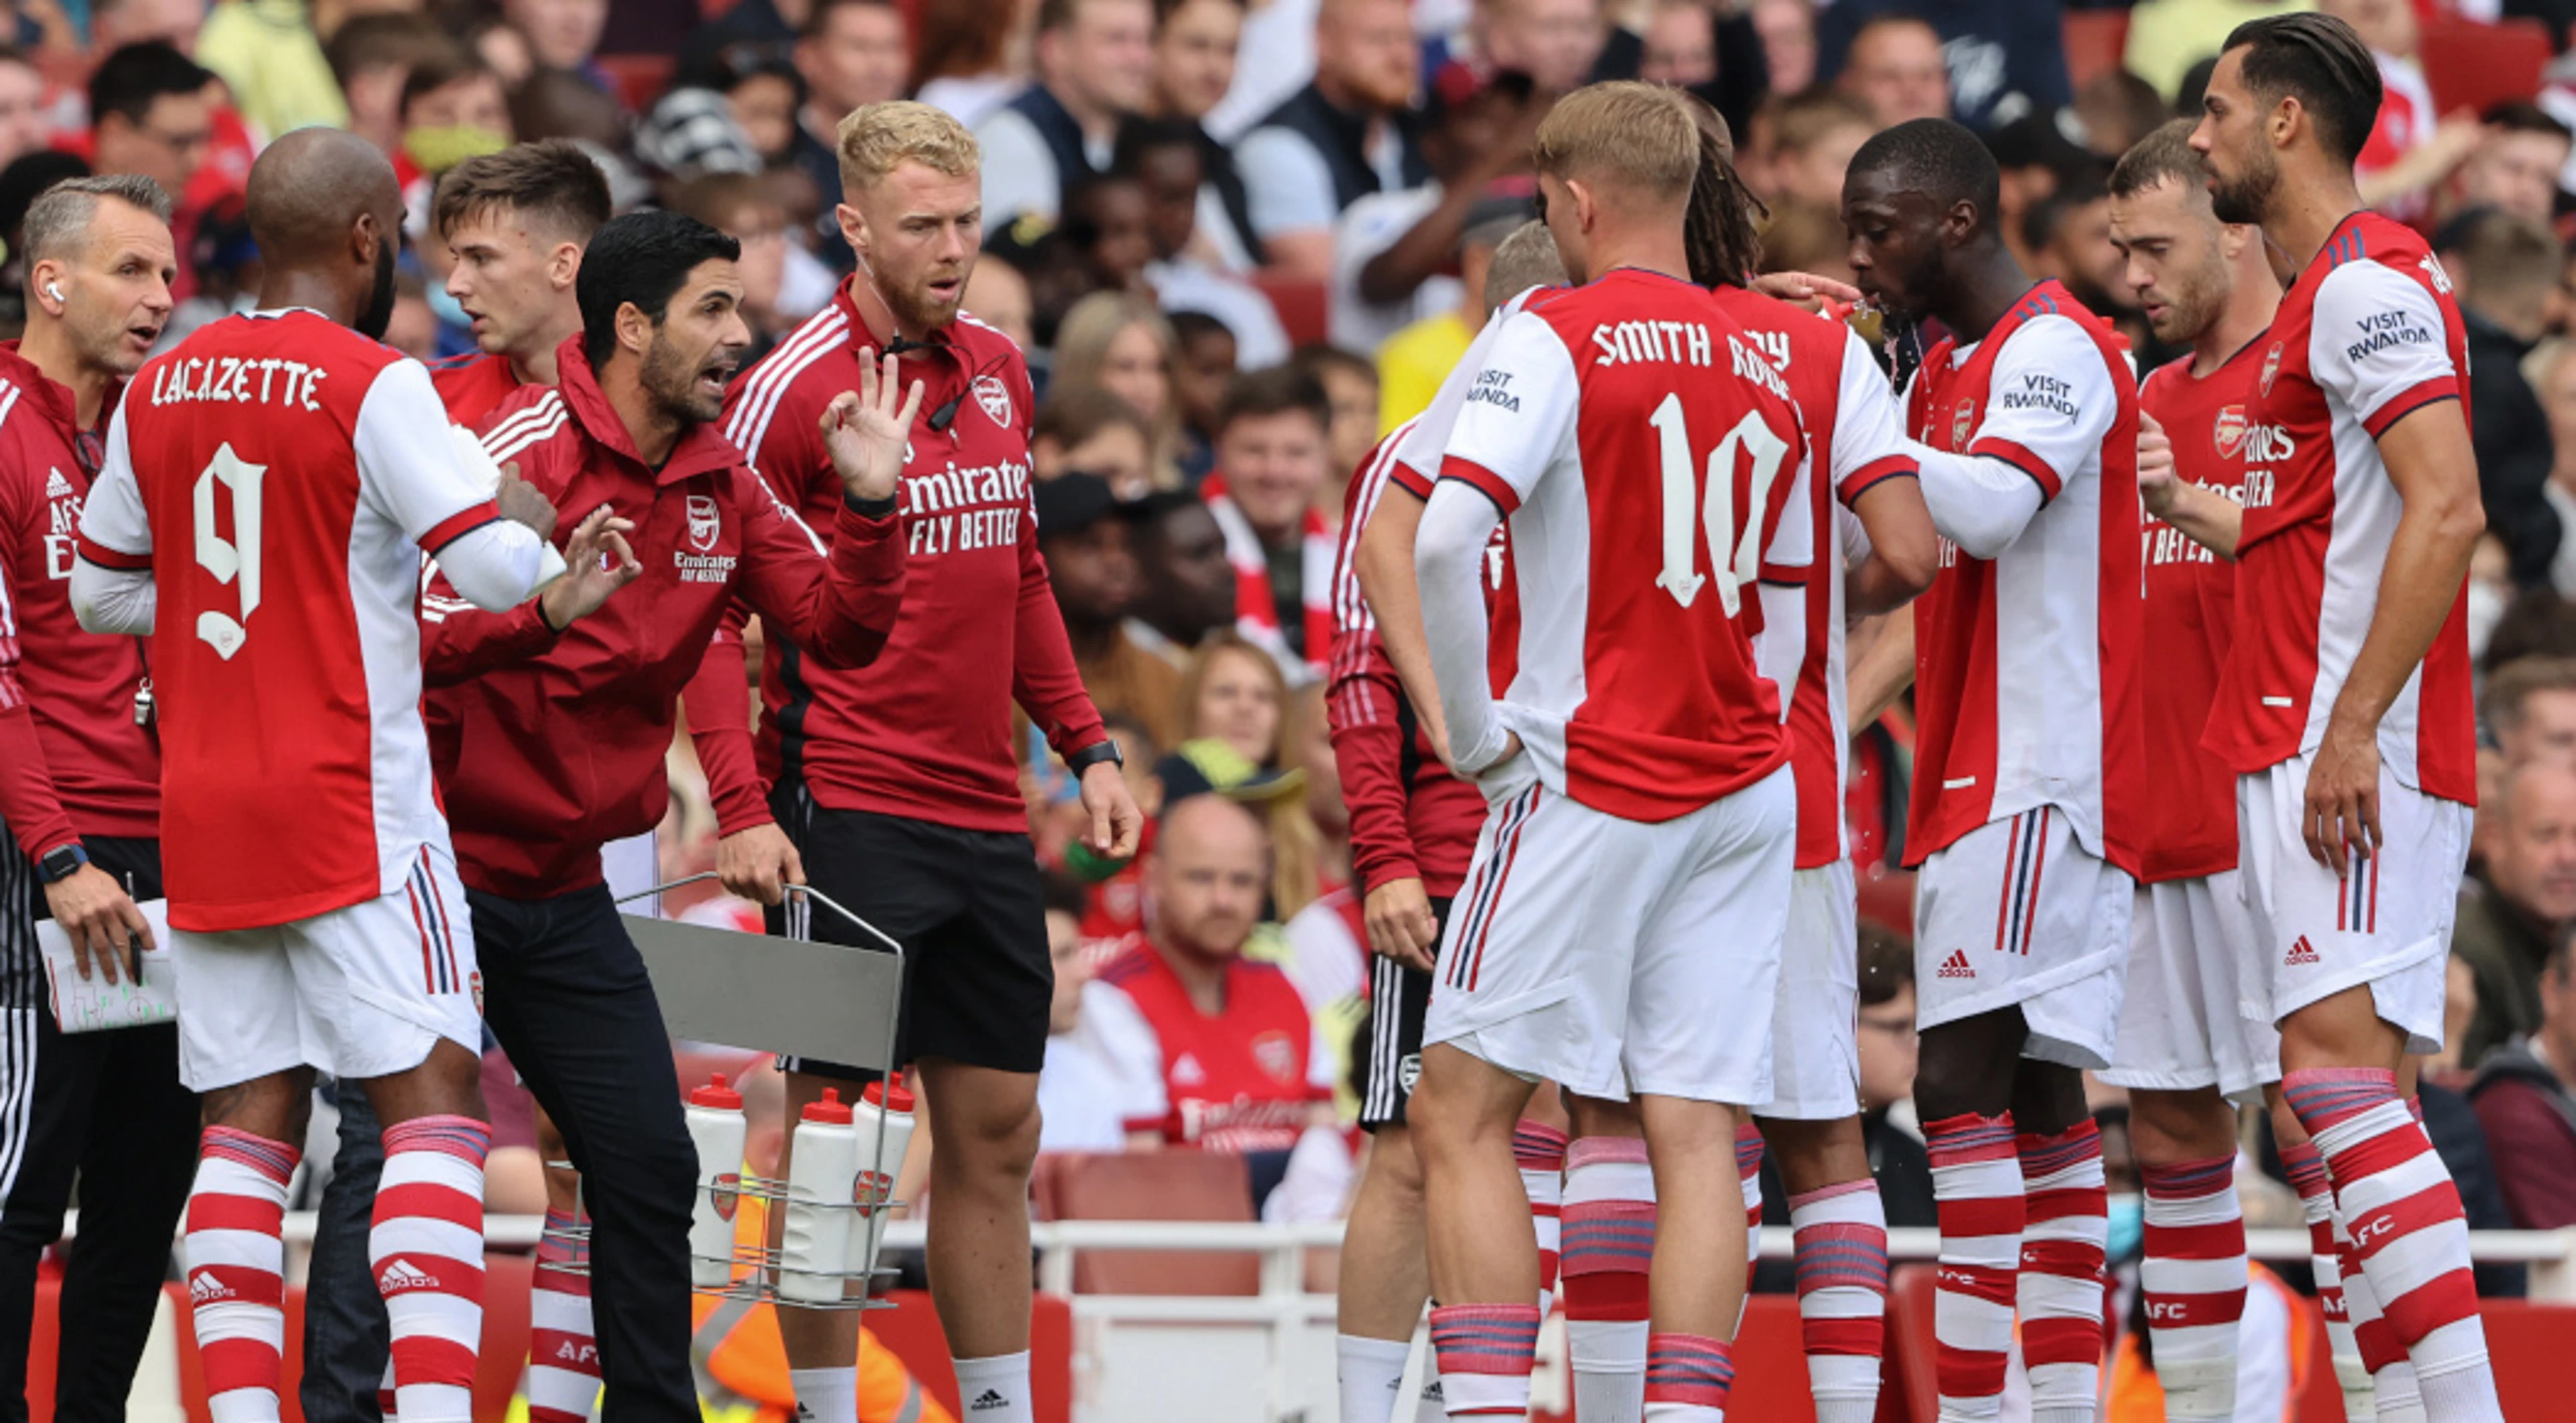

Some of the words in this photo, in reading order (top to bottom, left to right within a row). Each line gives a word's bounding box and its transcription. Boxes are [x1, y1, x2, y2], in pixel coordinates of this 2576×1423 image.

[1592, 320, 1712, 368] SMITH
[2356, 311, 2406, 333] VISIT
[151, 356, 327, 412] LACAZETTE
[2023, 374, 2072, 399] VISIT
[896, 458, 1027, 517] mirate
[1649, 392, 1789, 619] 10
[193, 441, 268, 661] 9
[909, 515, 953, 556] FLY
[1937, 968, 1976, 978] adidas
